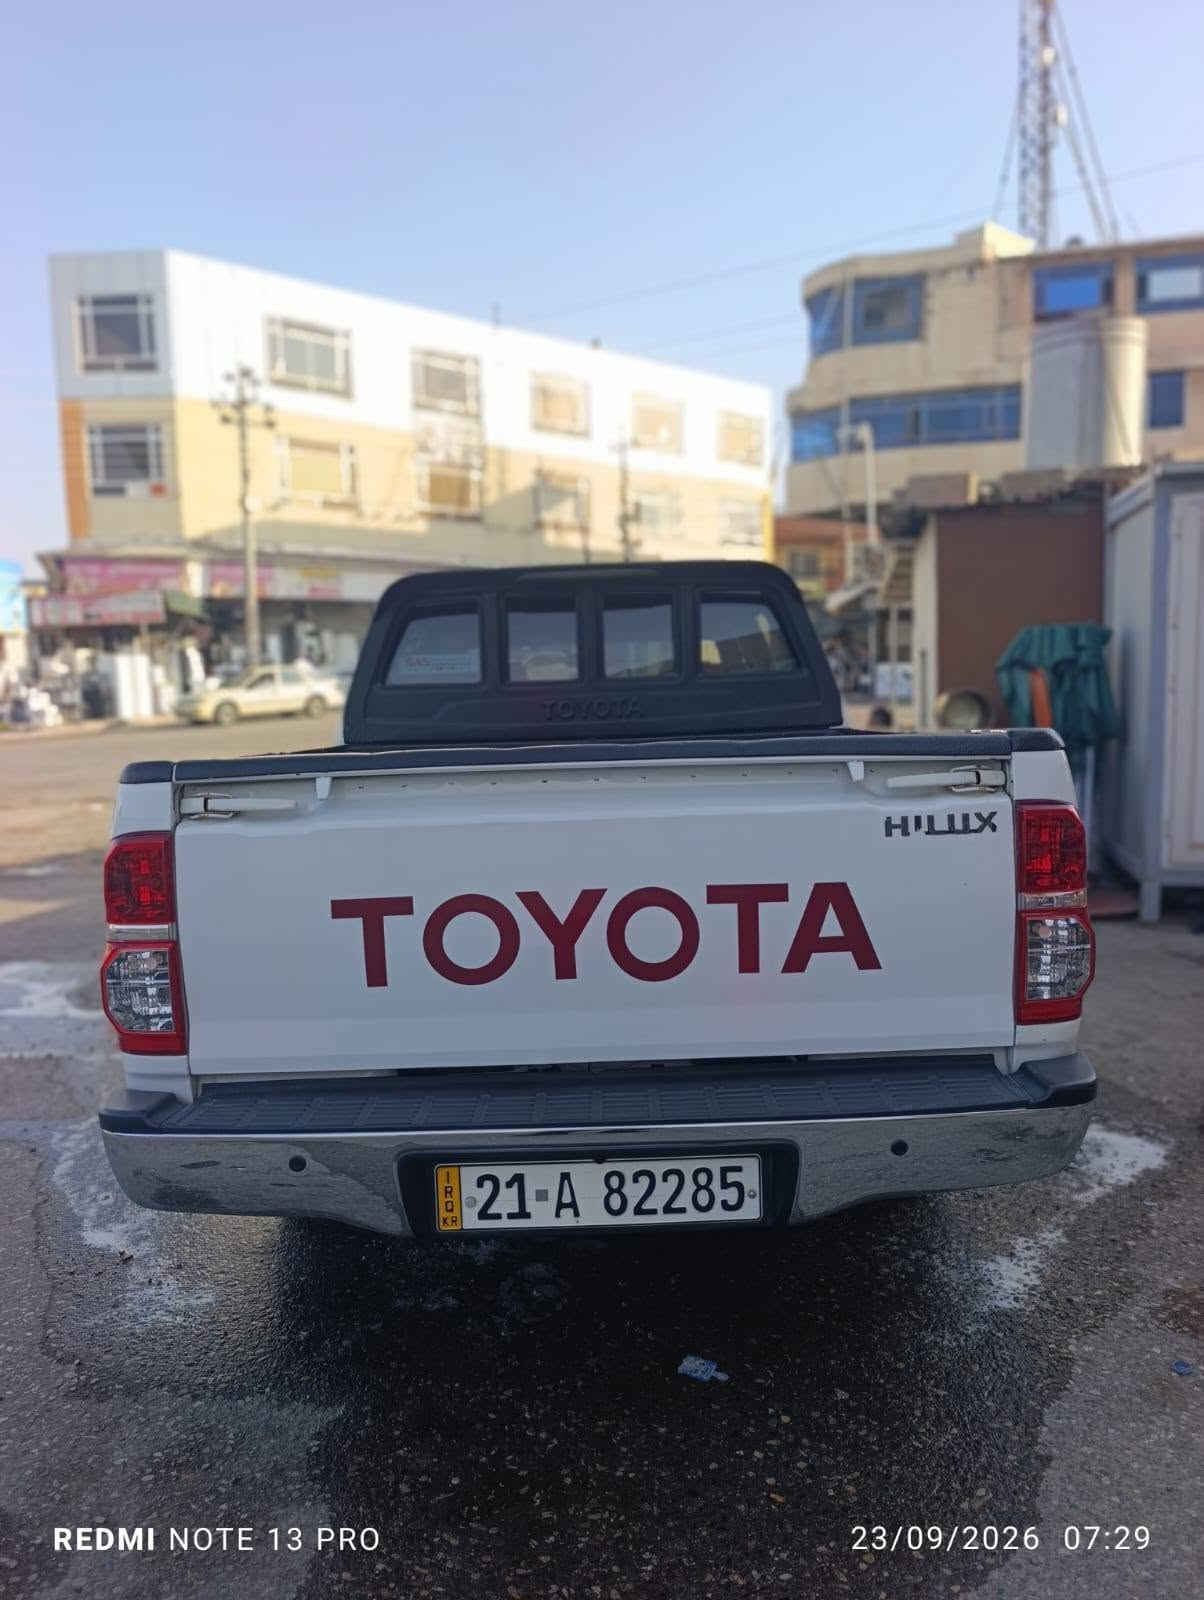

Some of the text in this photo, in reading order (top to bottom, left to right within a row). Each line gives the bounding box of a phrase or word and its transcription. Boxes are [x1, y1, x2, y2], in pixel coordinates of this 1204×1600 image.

[541, 697, 645, 721] TOYOTA
[884, 811, 998, 838] HILUX
[330, 881, 883, 988] TOYOTA
[444, 1170, 454, 1212] IRQ
[476, 1165, 746, 1221] 21 A 82285
[442, 1215, 458, 1227] KR
